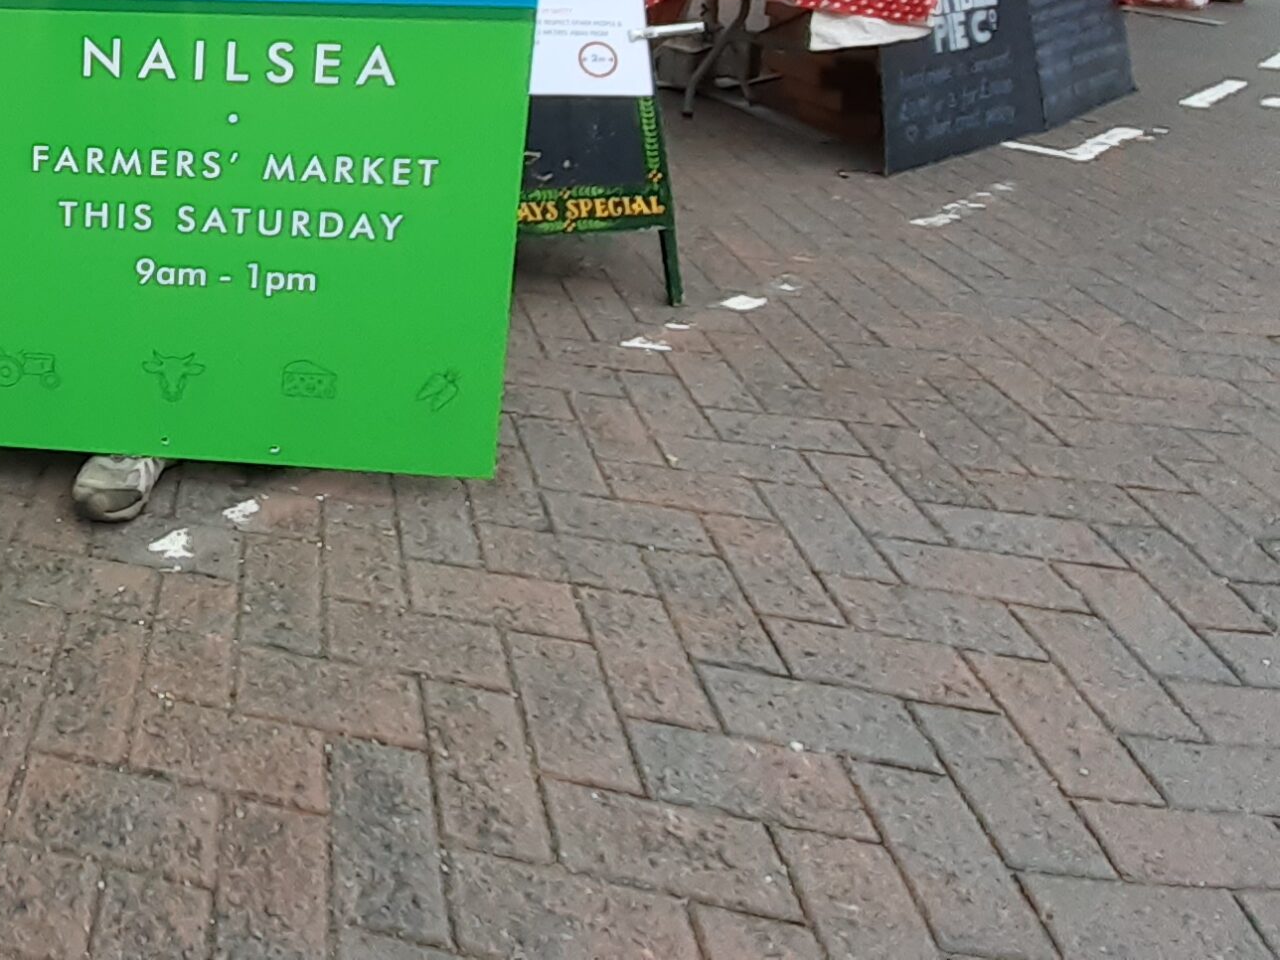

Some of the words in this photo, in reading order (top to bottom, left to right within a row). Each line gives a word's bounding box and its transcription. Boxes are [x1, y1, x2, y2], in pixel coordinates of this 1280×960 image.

[933, 11, 970, 54] PIE
[82, 36, 396, 87] NAILSEA
[262, 153, 440, 188] MARKET
[58, 200, 154, 232] THIS
[175, 205, 405, 242] SATURDAY
[517, 200, 559, 222] AYS
[564, 194, 666, 220] SPECIAL
[135, 257, 208, 288] 9am
[246, 262, 317, 297] 1pm
